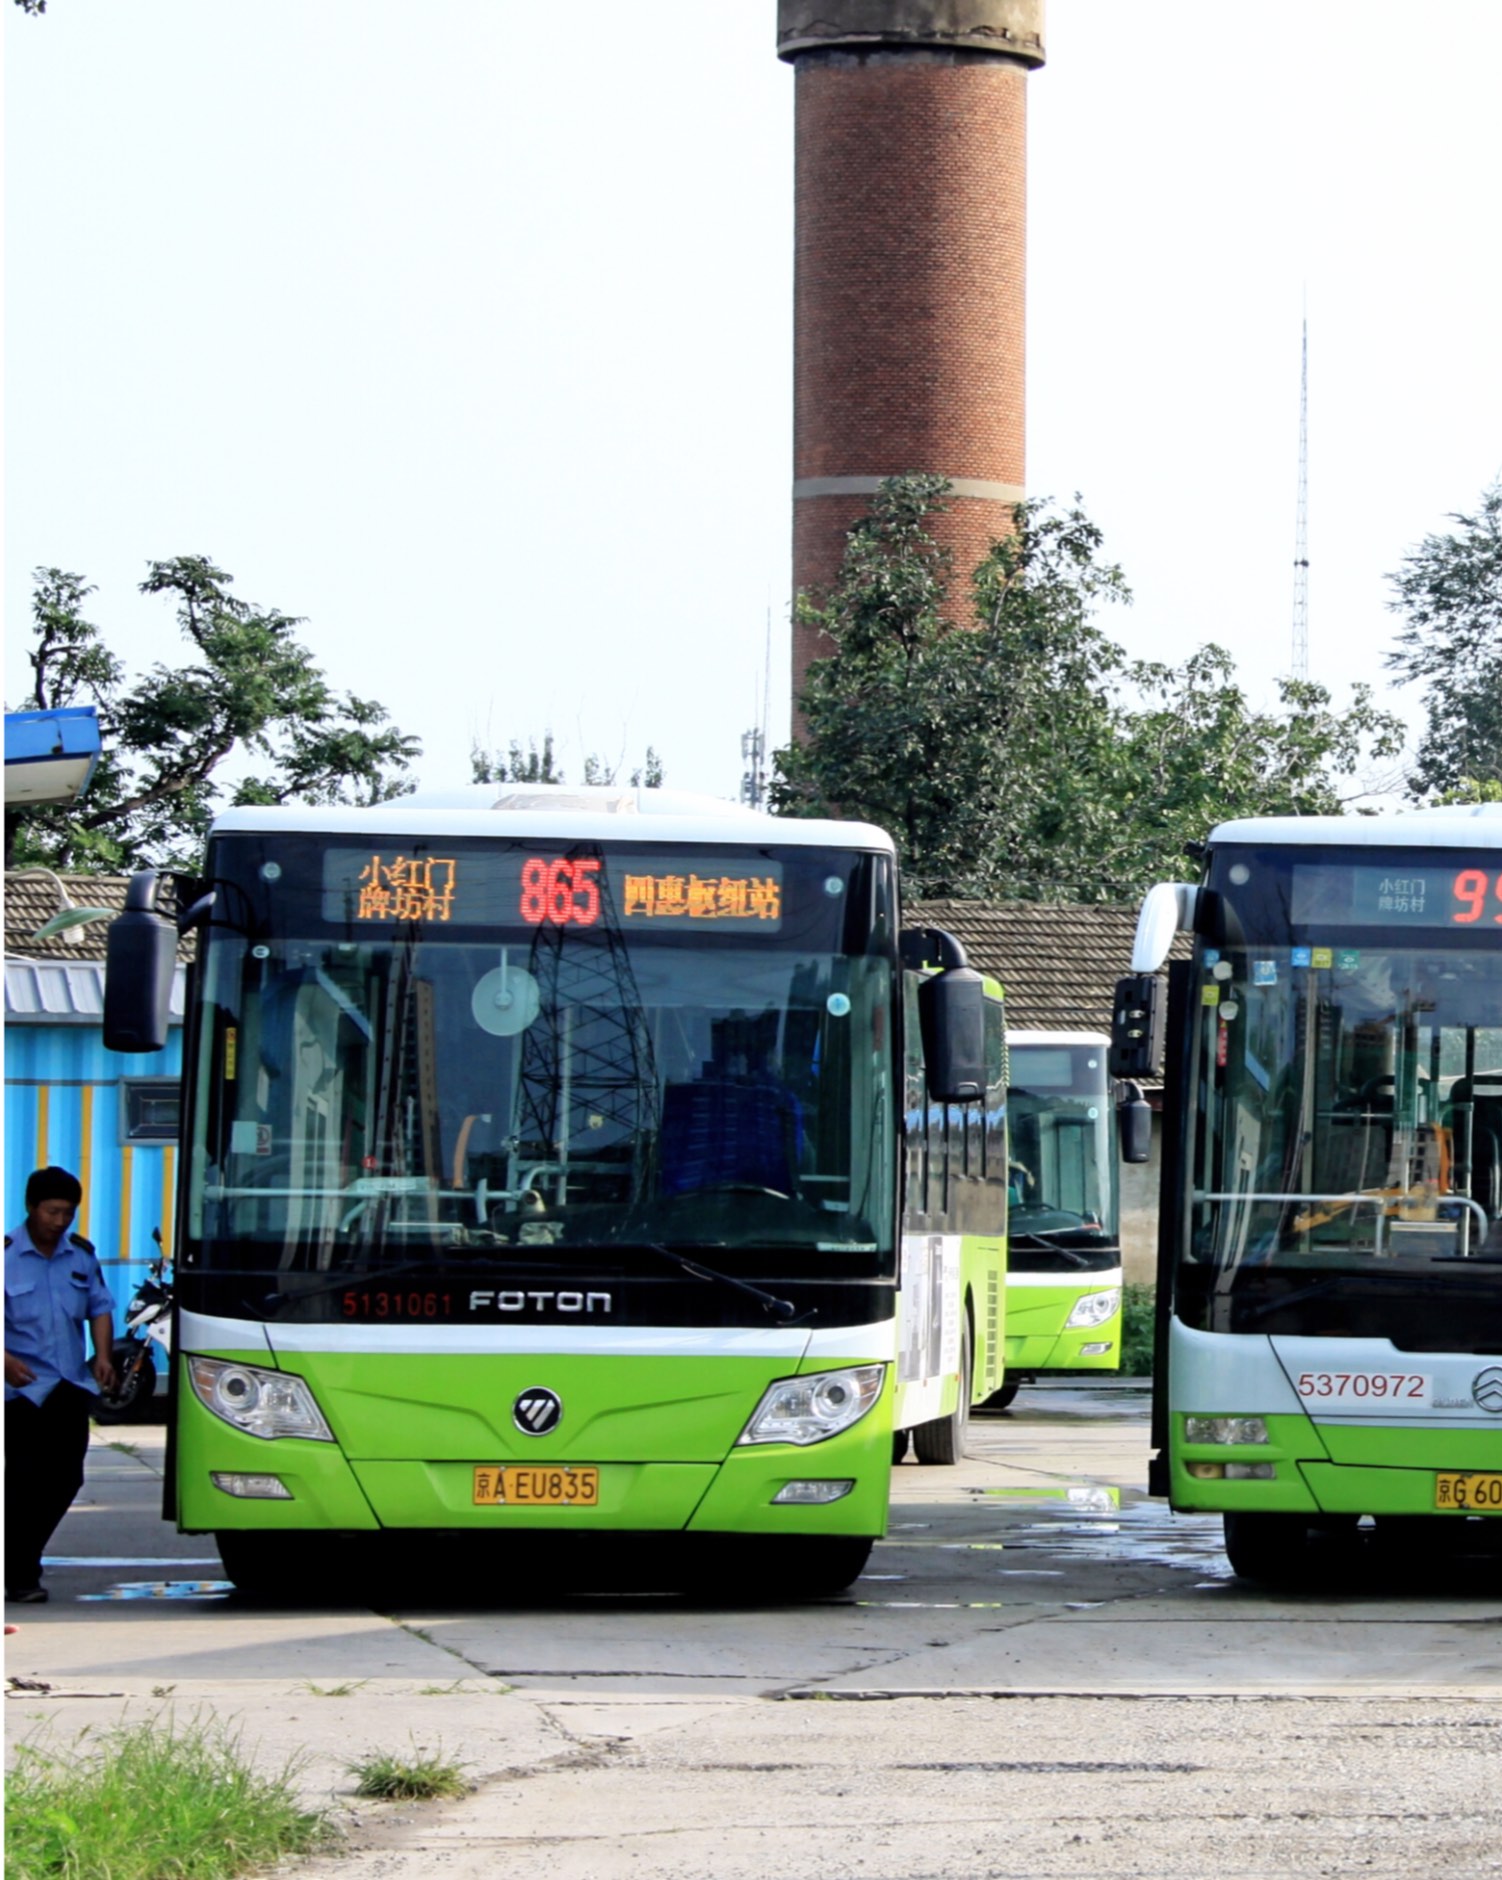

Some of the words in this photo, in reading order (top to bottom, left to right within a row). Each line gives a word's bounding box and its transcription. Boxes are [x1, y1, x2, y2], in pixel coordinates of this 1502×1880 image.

[358, 856, 456, 889] 小红门
[519, 858, 600, 924] 865
[623, 873, 780, 919] 四惠枢纽站
[1379, 878, 1426, 895] 小红门
[358, 887, 456, 921] 牌坊村
[1378, 896, 1426, 913] 牌坊村
[343, 1292, 450, 1316] 5131061
[469, 1291, 612, 1312] FOTON
[1299, 1374, 1424, 1397] 5370972
